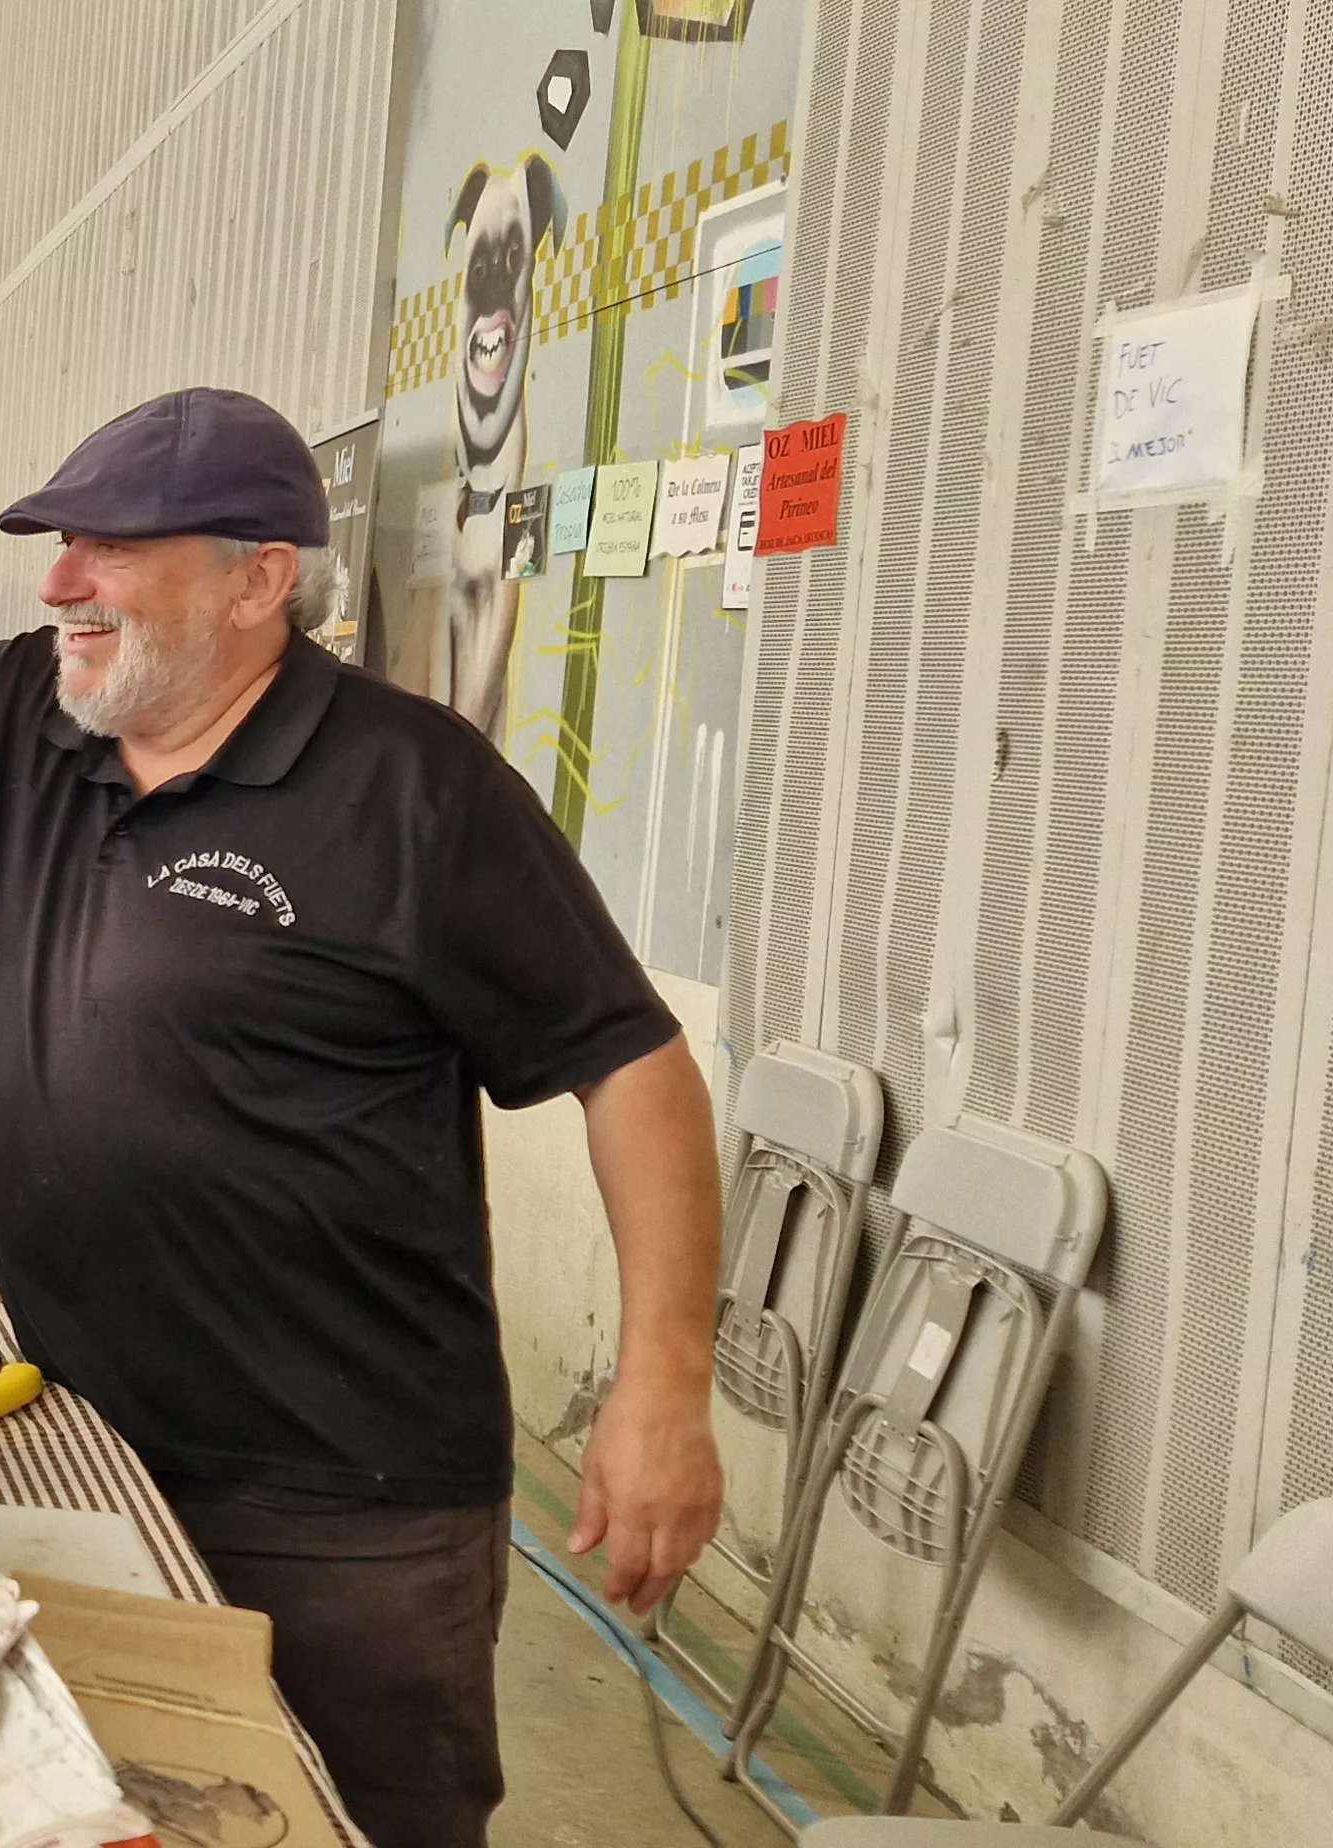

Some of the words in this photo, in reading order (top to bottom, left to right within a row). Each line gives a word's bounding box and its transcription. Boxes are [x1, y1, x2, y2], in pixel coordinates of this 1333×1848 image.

[1118, 342, 1166, 378] FUET
[768, 434, 791, 459] OZ
[800, 423, 839, 452] MIEL
[333, 443, 355, 487] Miel
[766, 462, 818, 492] Artesanal
[820, 457, 837, 481] del
[779, 497, 820, 520] Pirineo
[146, 864, 171, 889] LA
[173, 850, 220, 874] CASA
[220, 851, 264, 881] DELS
[256, 872, 297, 928] FUETS
[169, 876, 209, 900] DESDE
